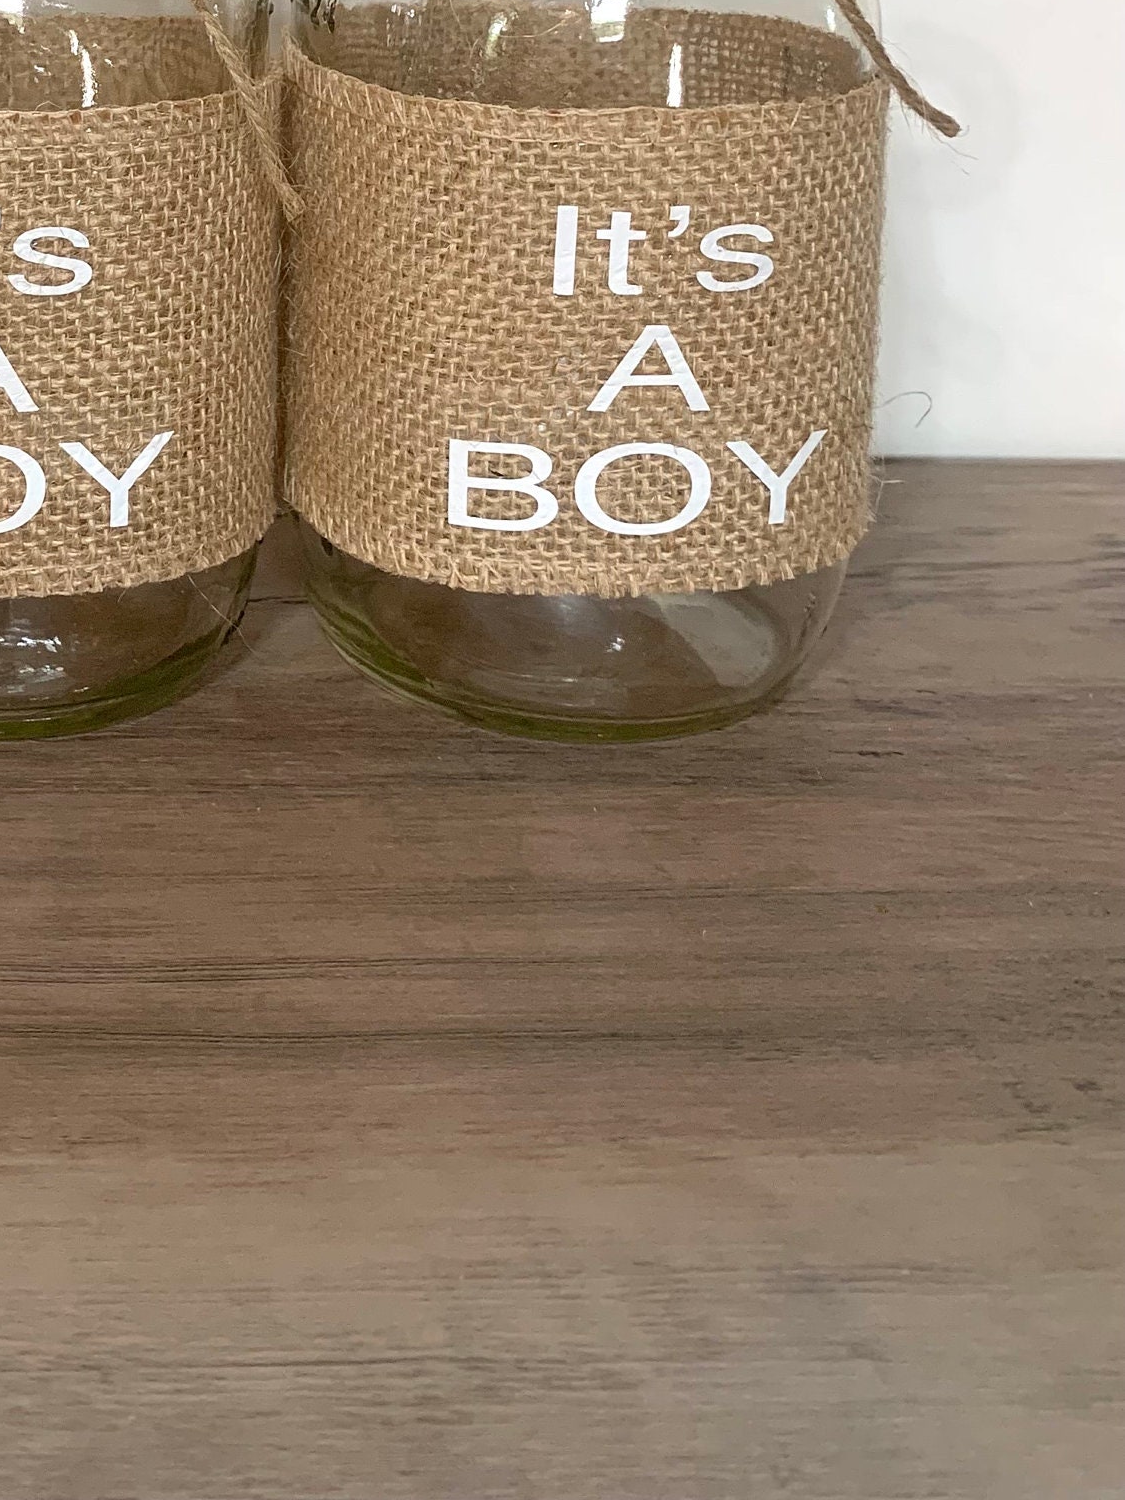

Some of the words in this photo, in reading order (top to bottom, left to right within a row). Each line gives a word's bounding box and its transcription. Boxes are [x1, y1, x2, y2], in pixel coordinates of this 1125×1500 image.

[552, 204, 775, 296] It's
[586, 324, 711, 413] A
[445, 429, 828, 537] BOY
